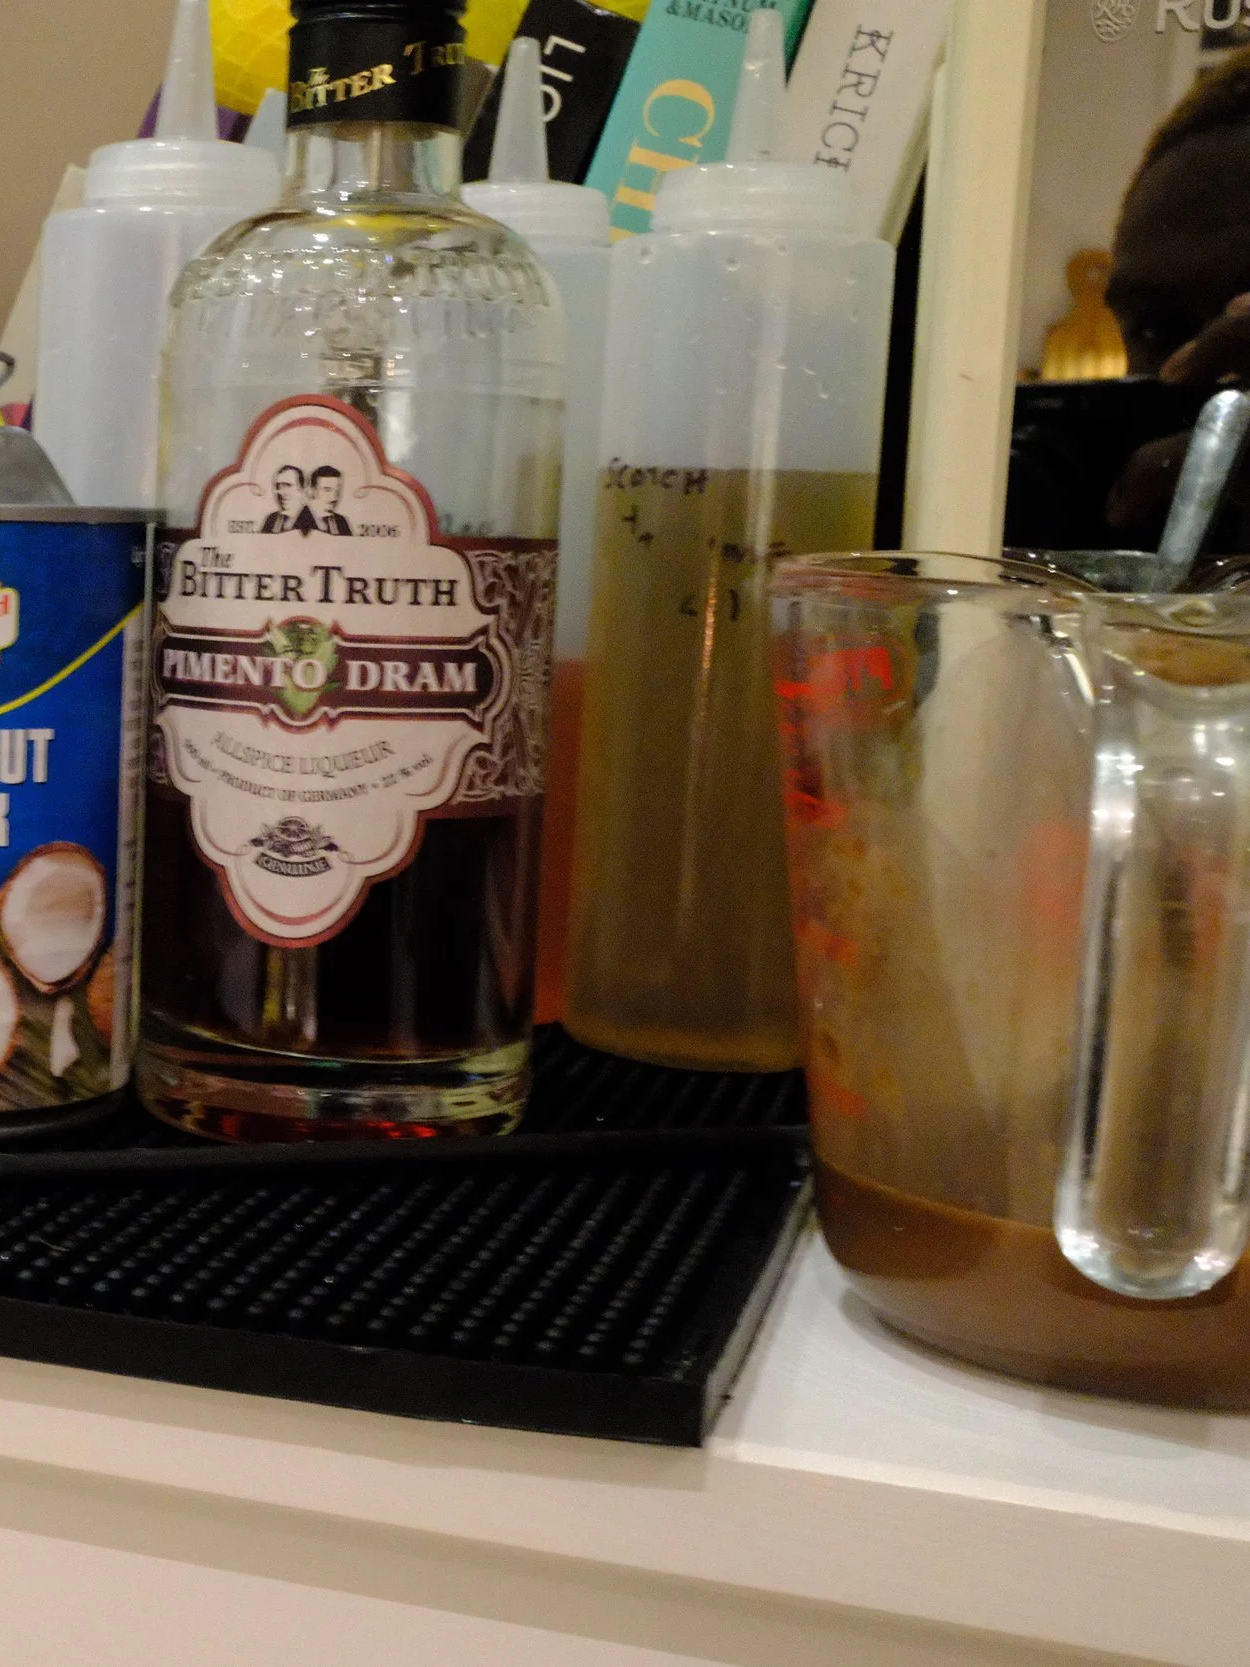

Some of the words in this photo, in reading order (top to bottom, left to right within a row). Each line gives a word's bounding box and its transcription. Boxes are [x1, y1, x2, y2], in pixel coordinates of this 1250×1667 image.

[201, 546, 236, 568] The
[180, 560, 305, 603] BITTER
[312, 565, 460, 607] TRUTH
[161, 648, 328, 690] PIMENTO
[345, 659, 479, 693] DRAM
[210, 731, 295, 775] ALLSPICE
[298, 740, 398, 779] LIQUEUR
[217, 770, 276, 800] PRODUCT
[277, 788, 297, 803] OF
[297, 782, 370, 803] GERMANY
